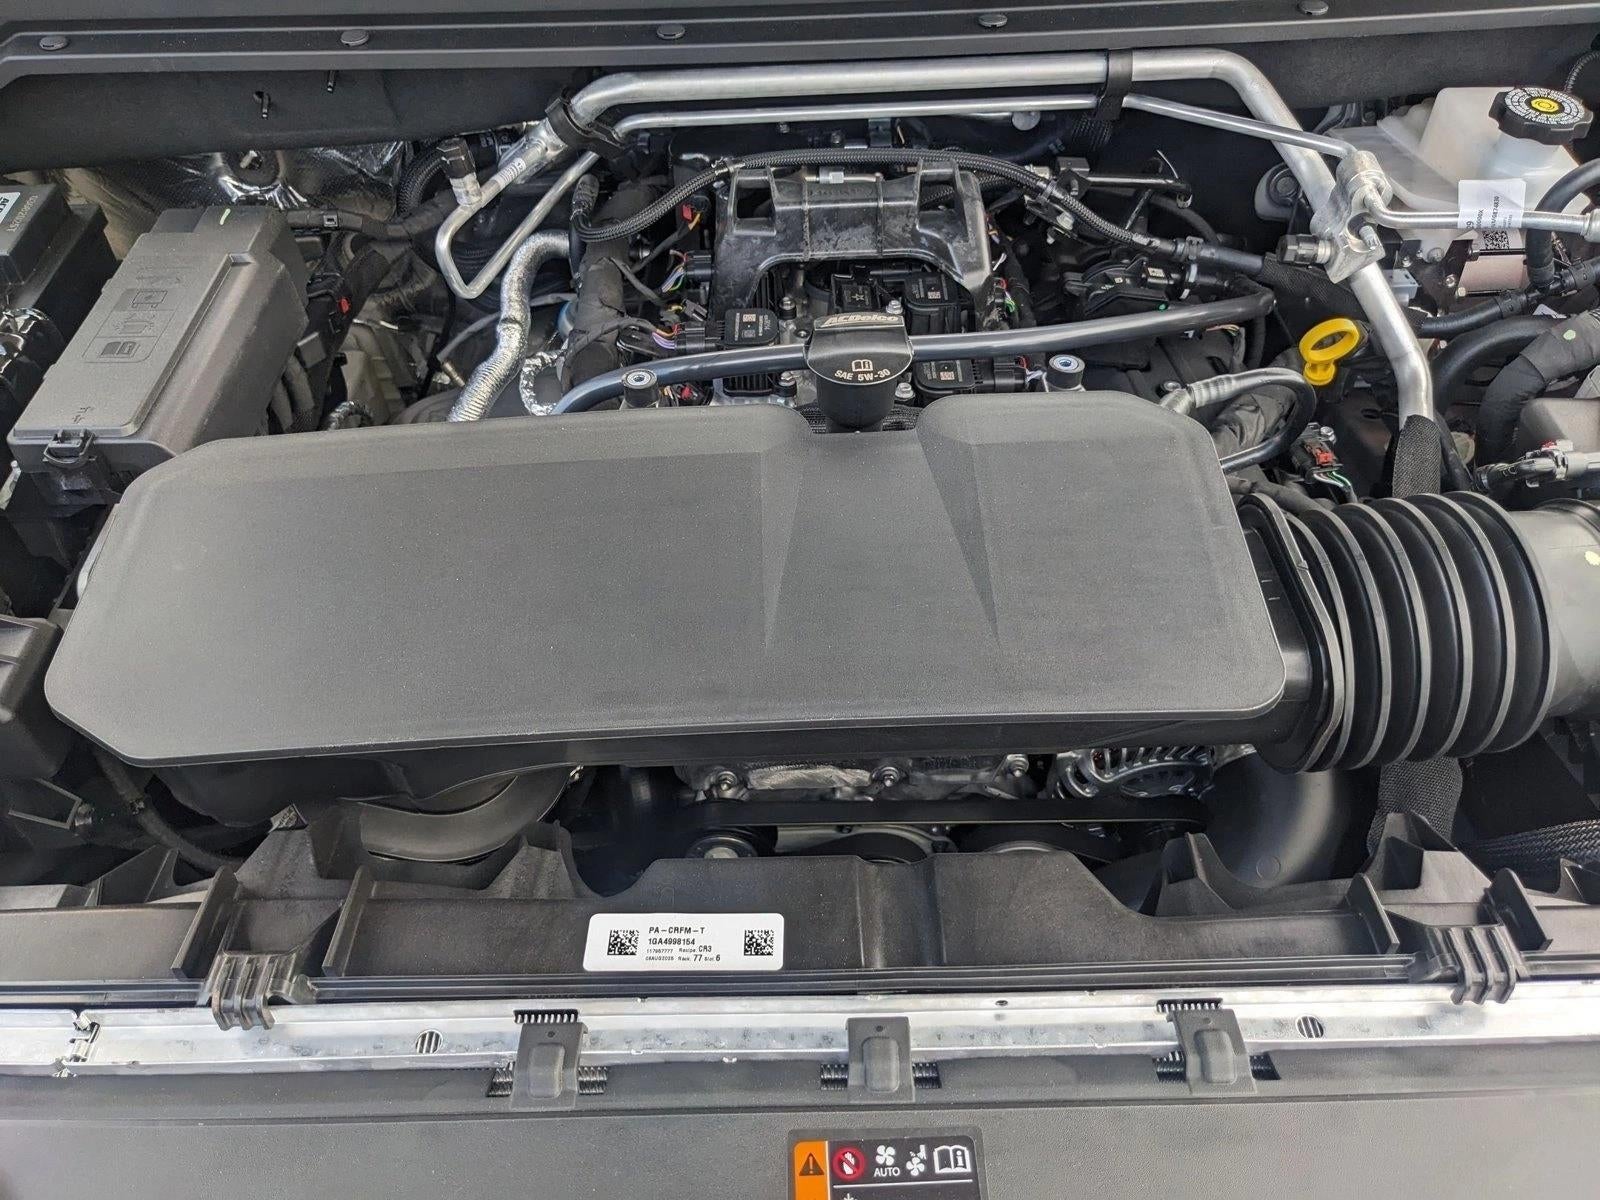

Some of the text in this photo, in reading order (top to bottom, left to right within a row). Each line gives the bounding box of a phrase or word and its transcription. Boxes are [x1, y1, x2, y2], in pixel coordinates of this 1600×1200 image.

[821, 315, 899, 327] ACDelco
[835, 369, 891, 381] SAE 5W-30
[874, 1167, 900, 1177] AUTO
